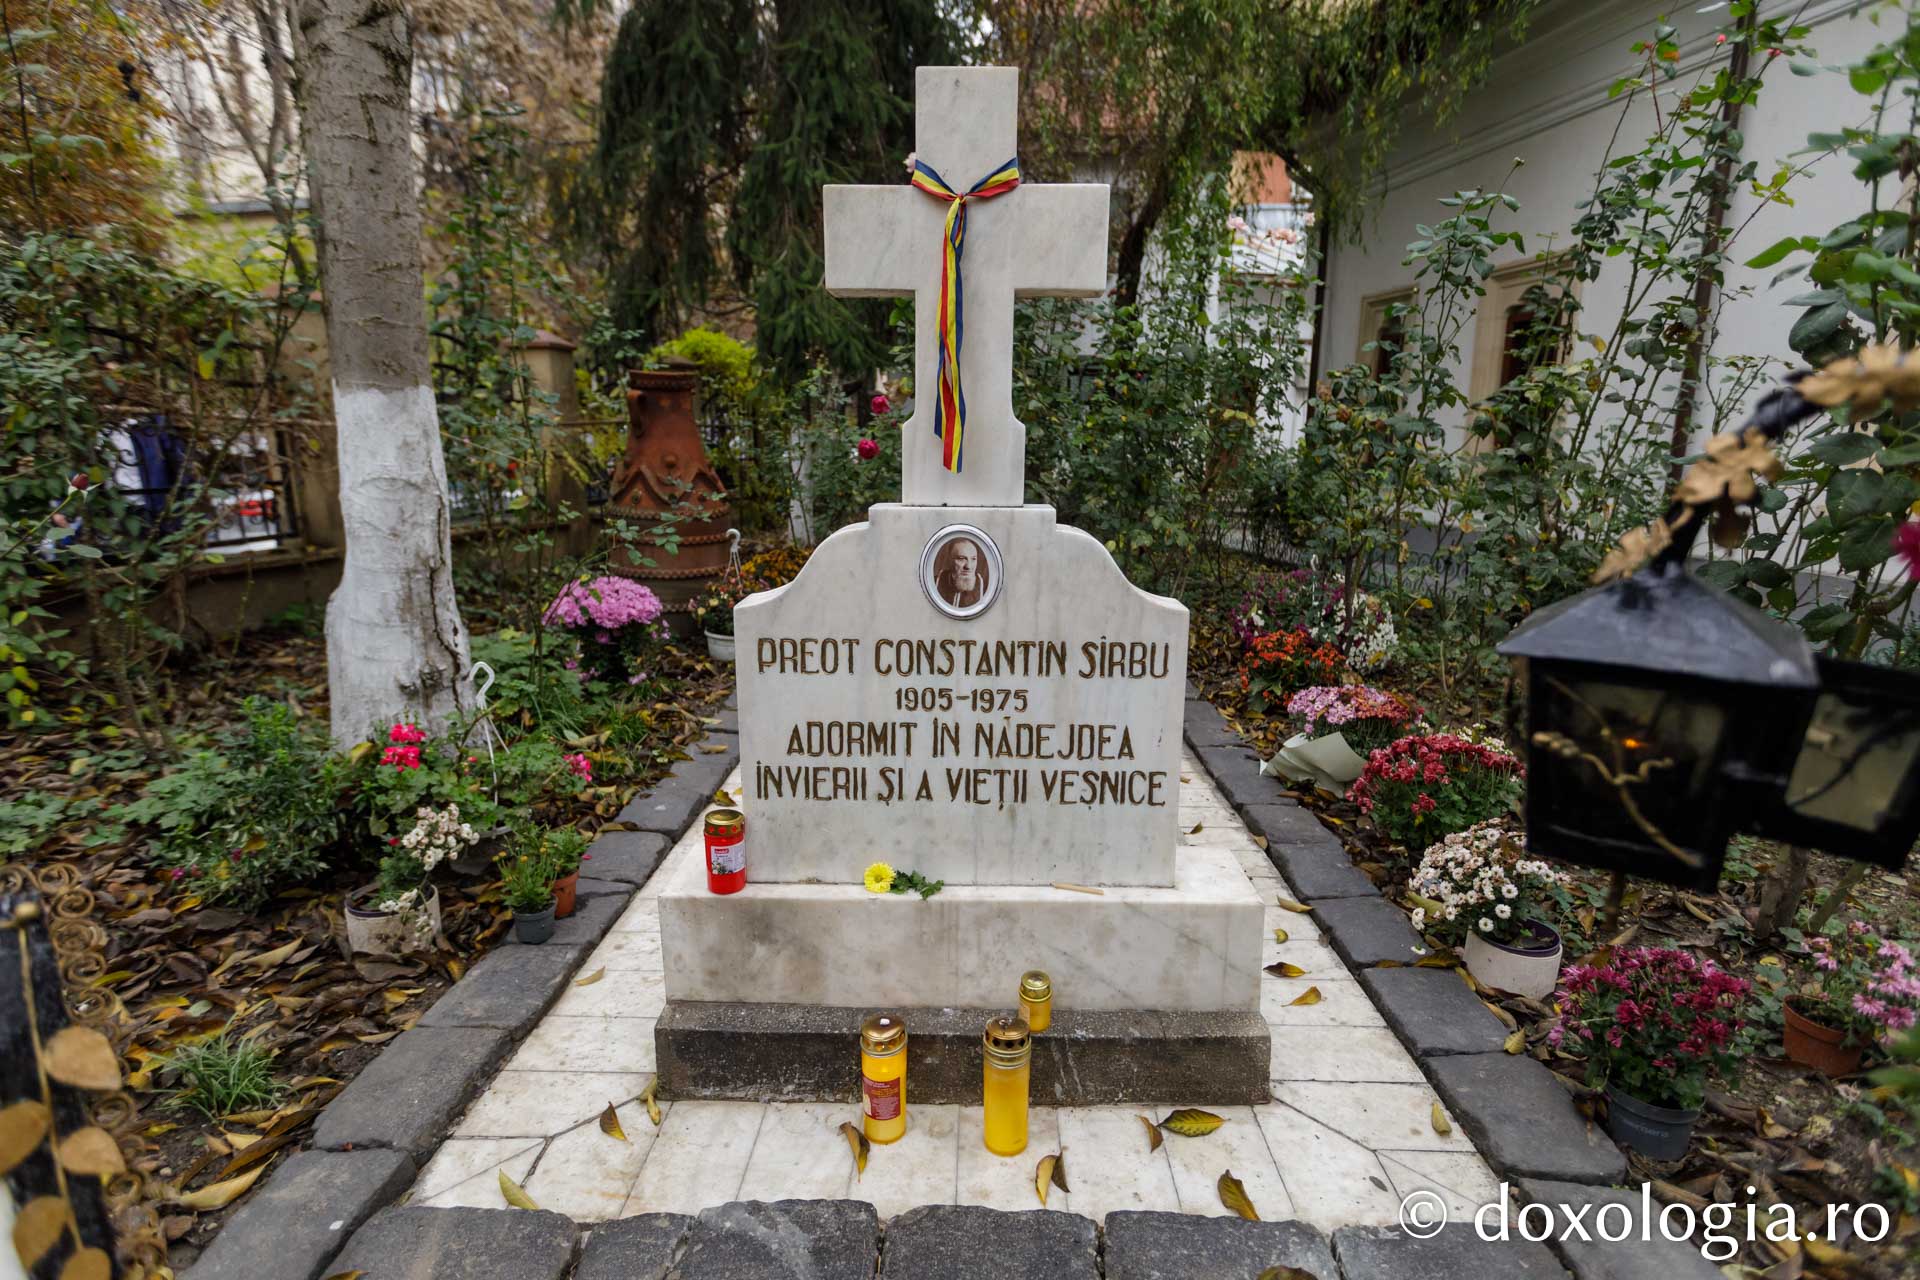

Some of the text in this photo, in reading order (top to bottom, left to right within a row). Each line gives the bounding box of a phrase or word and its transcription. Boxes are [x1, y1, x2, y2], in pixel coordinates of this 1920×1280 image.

[757, 638, 860, 674] PREOT
[874, 639, 1067, 677] CONSTANTIN
[895, 687, 1029, 713] 1905-1975
[786, 721, 918, 758] ADORMIT
[915, 769, 934, 802] A
